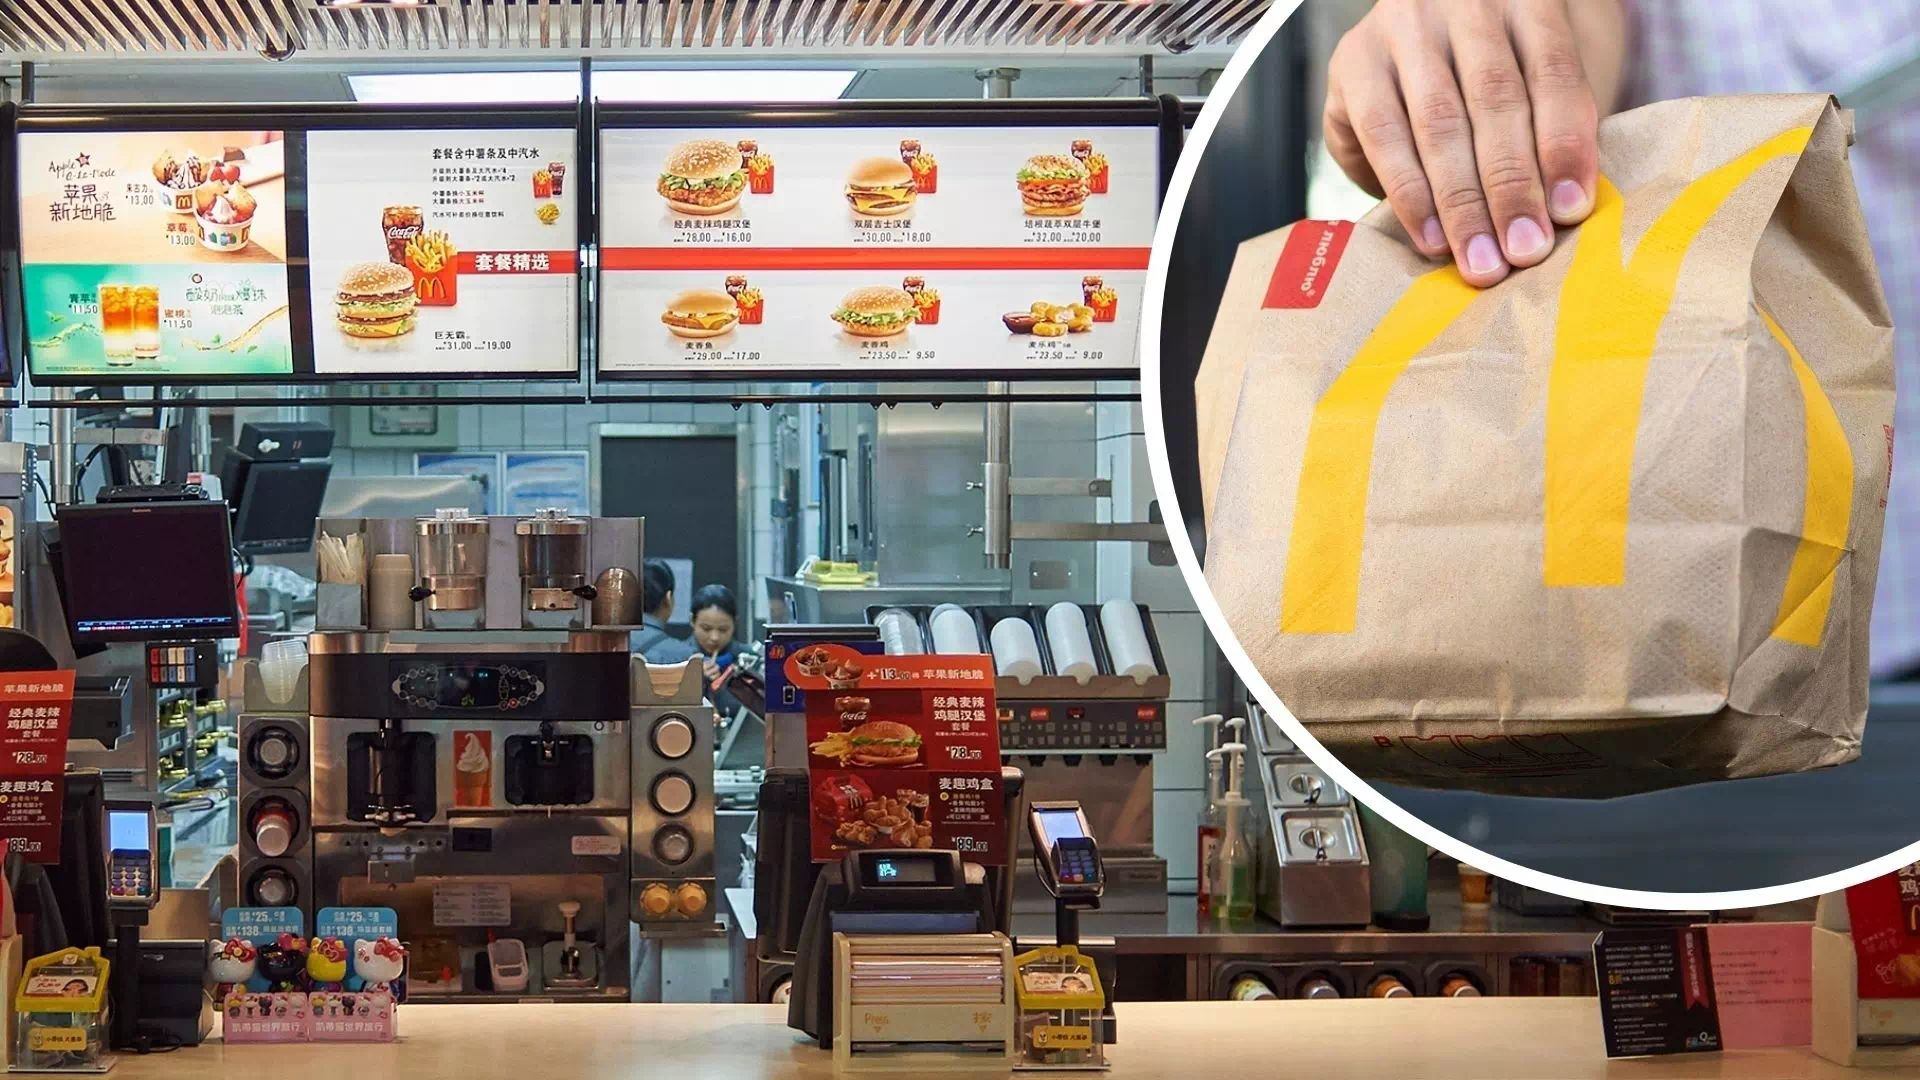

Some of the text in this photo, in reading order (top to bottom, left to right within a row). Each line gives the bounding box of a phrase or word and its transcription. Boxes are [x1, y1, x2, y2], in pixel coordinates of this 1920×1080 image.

[432, 148, 540, 160] 套餐含中薯条及中汽水
[64, 184, 98, 205] 苹果
[49, 202, 116, 222] 新地脆
[674, 220, 750, 228] 经典麦辣鸡腿汉堡
[854, 220, 912, 228] 双层吉士汉堡
[476, 252, 550, 272] 套餐精选
[435, 331, 465, 340] 巨无霸
[923, 669, 984, 680] 苹果新地脆
[933, 696, 986, 708] 经典麦辣
[8, 706, 60, 718] 经典麦辣
[934, 710, 986, 721] 鸡腿汉堡
[6, 718, 58, 730] 鸡腿汉堡
[0, 780, 54, 792] 麦趣鸡盒
[939, 778, 994, 790] 麦趣鸡盒
